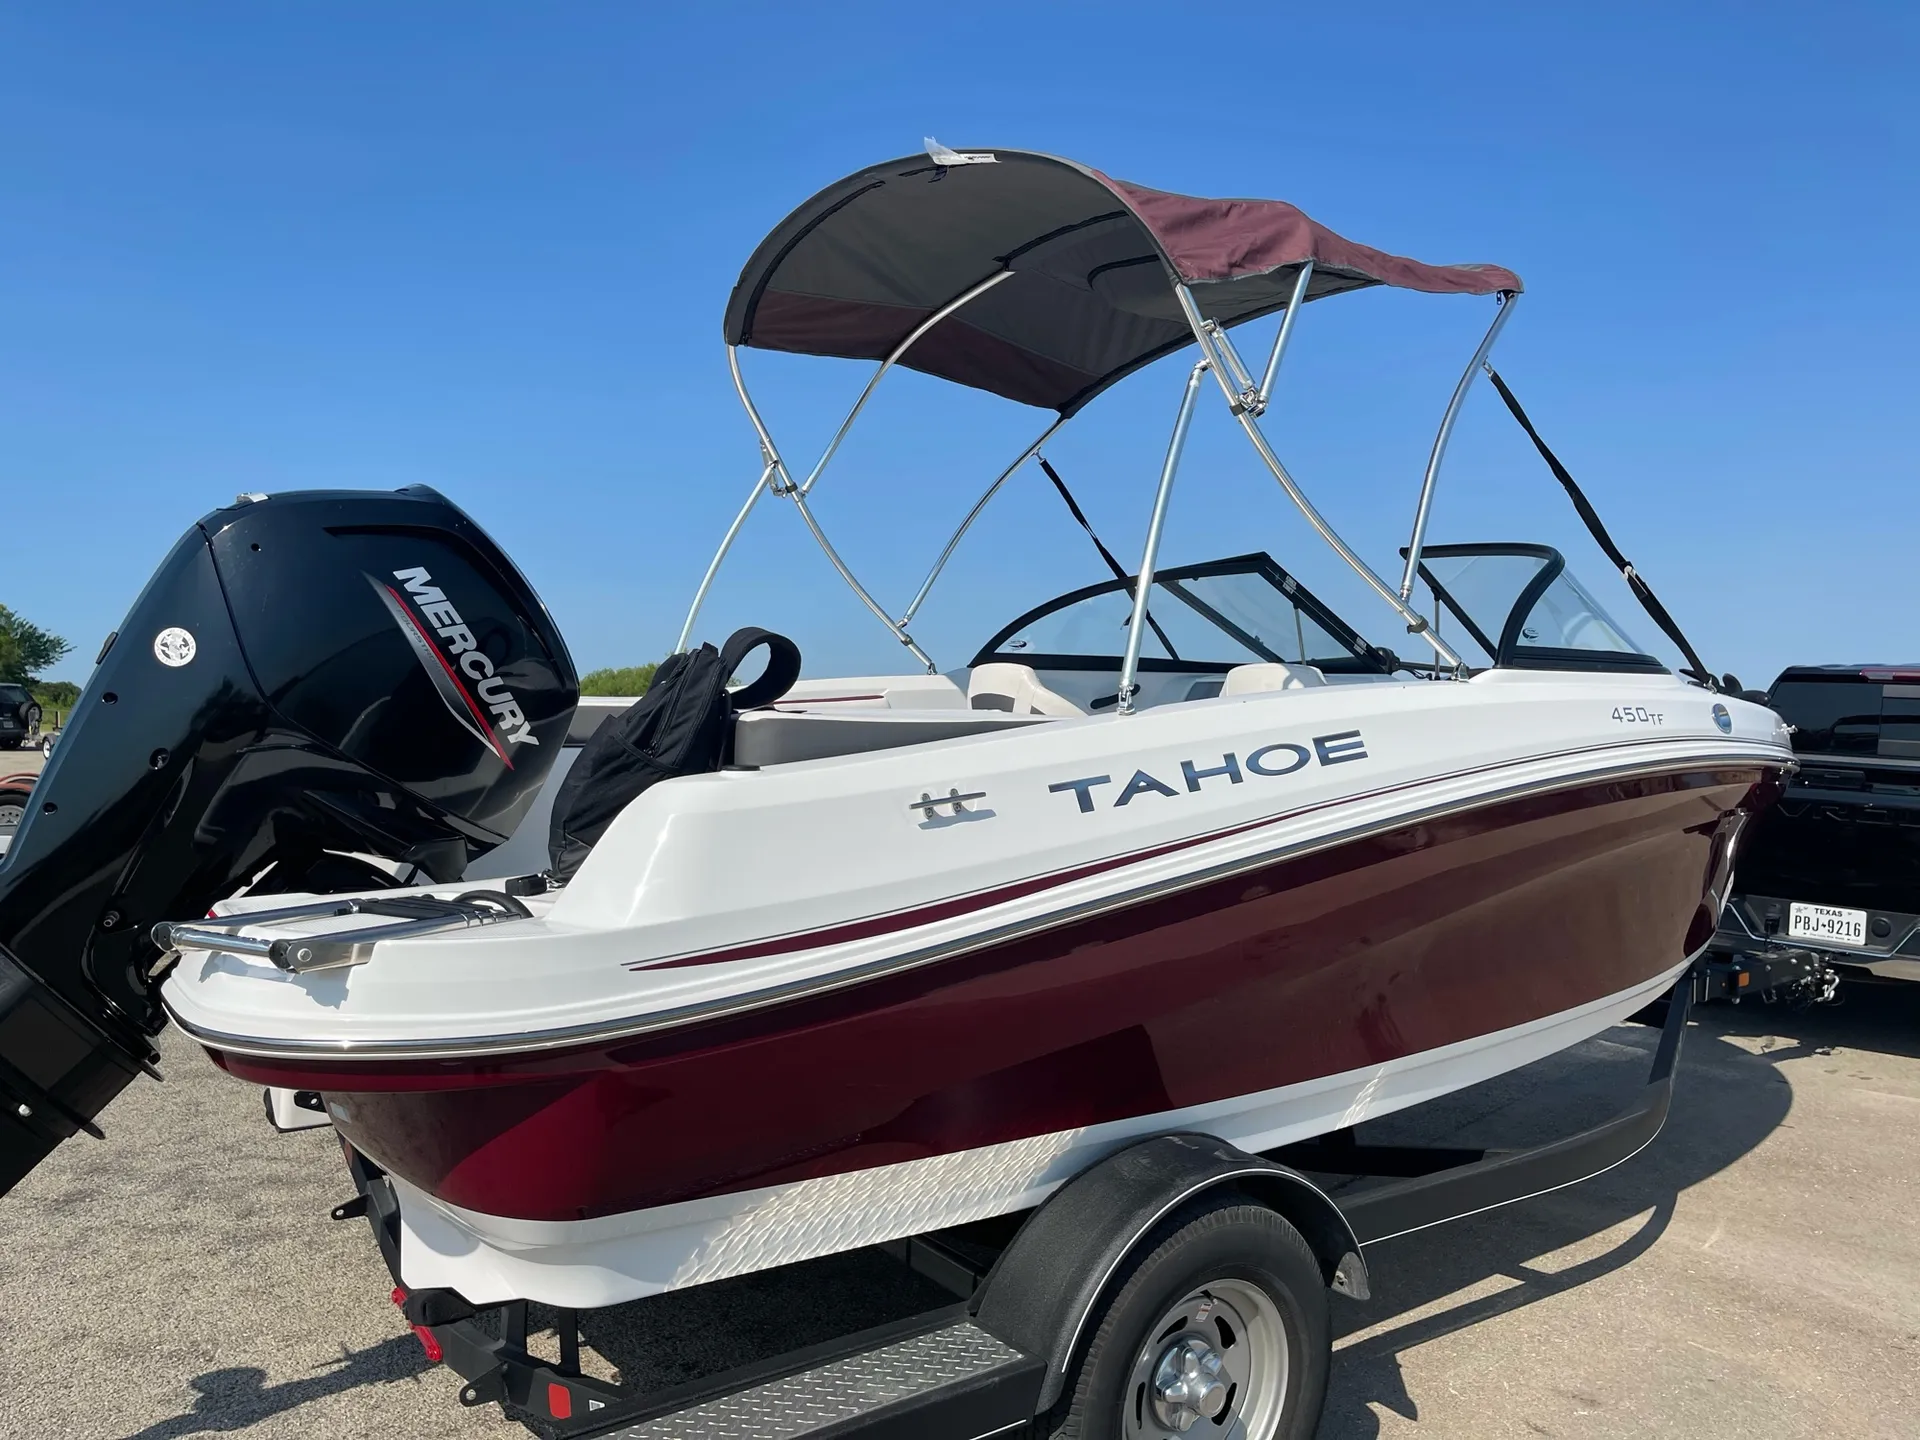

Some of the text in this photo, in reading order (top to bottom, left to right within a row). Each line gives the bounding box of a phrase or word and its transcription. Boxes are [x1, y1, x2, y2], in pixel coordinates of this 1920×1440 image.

[392, 566, 540, 746] MERCURY
[1048, 729, 1369, 814] TAHOE
[1814, 907, 1843, 918] TEXAS
